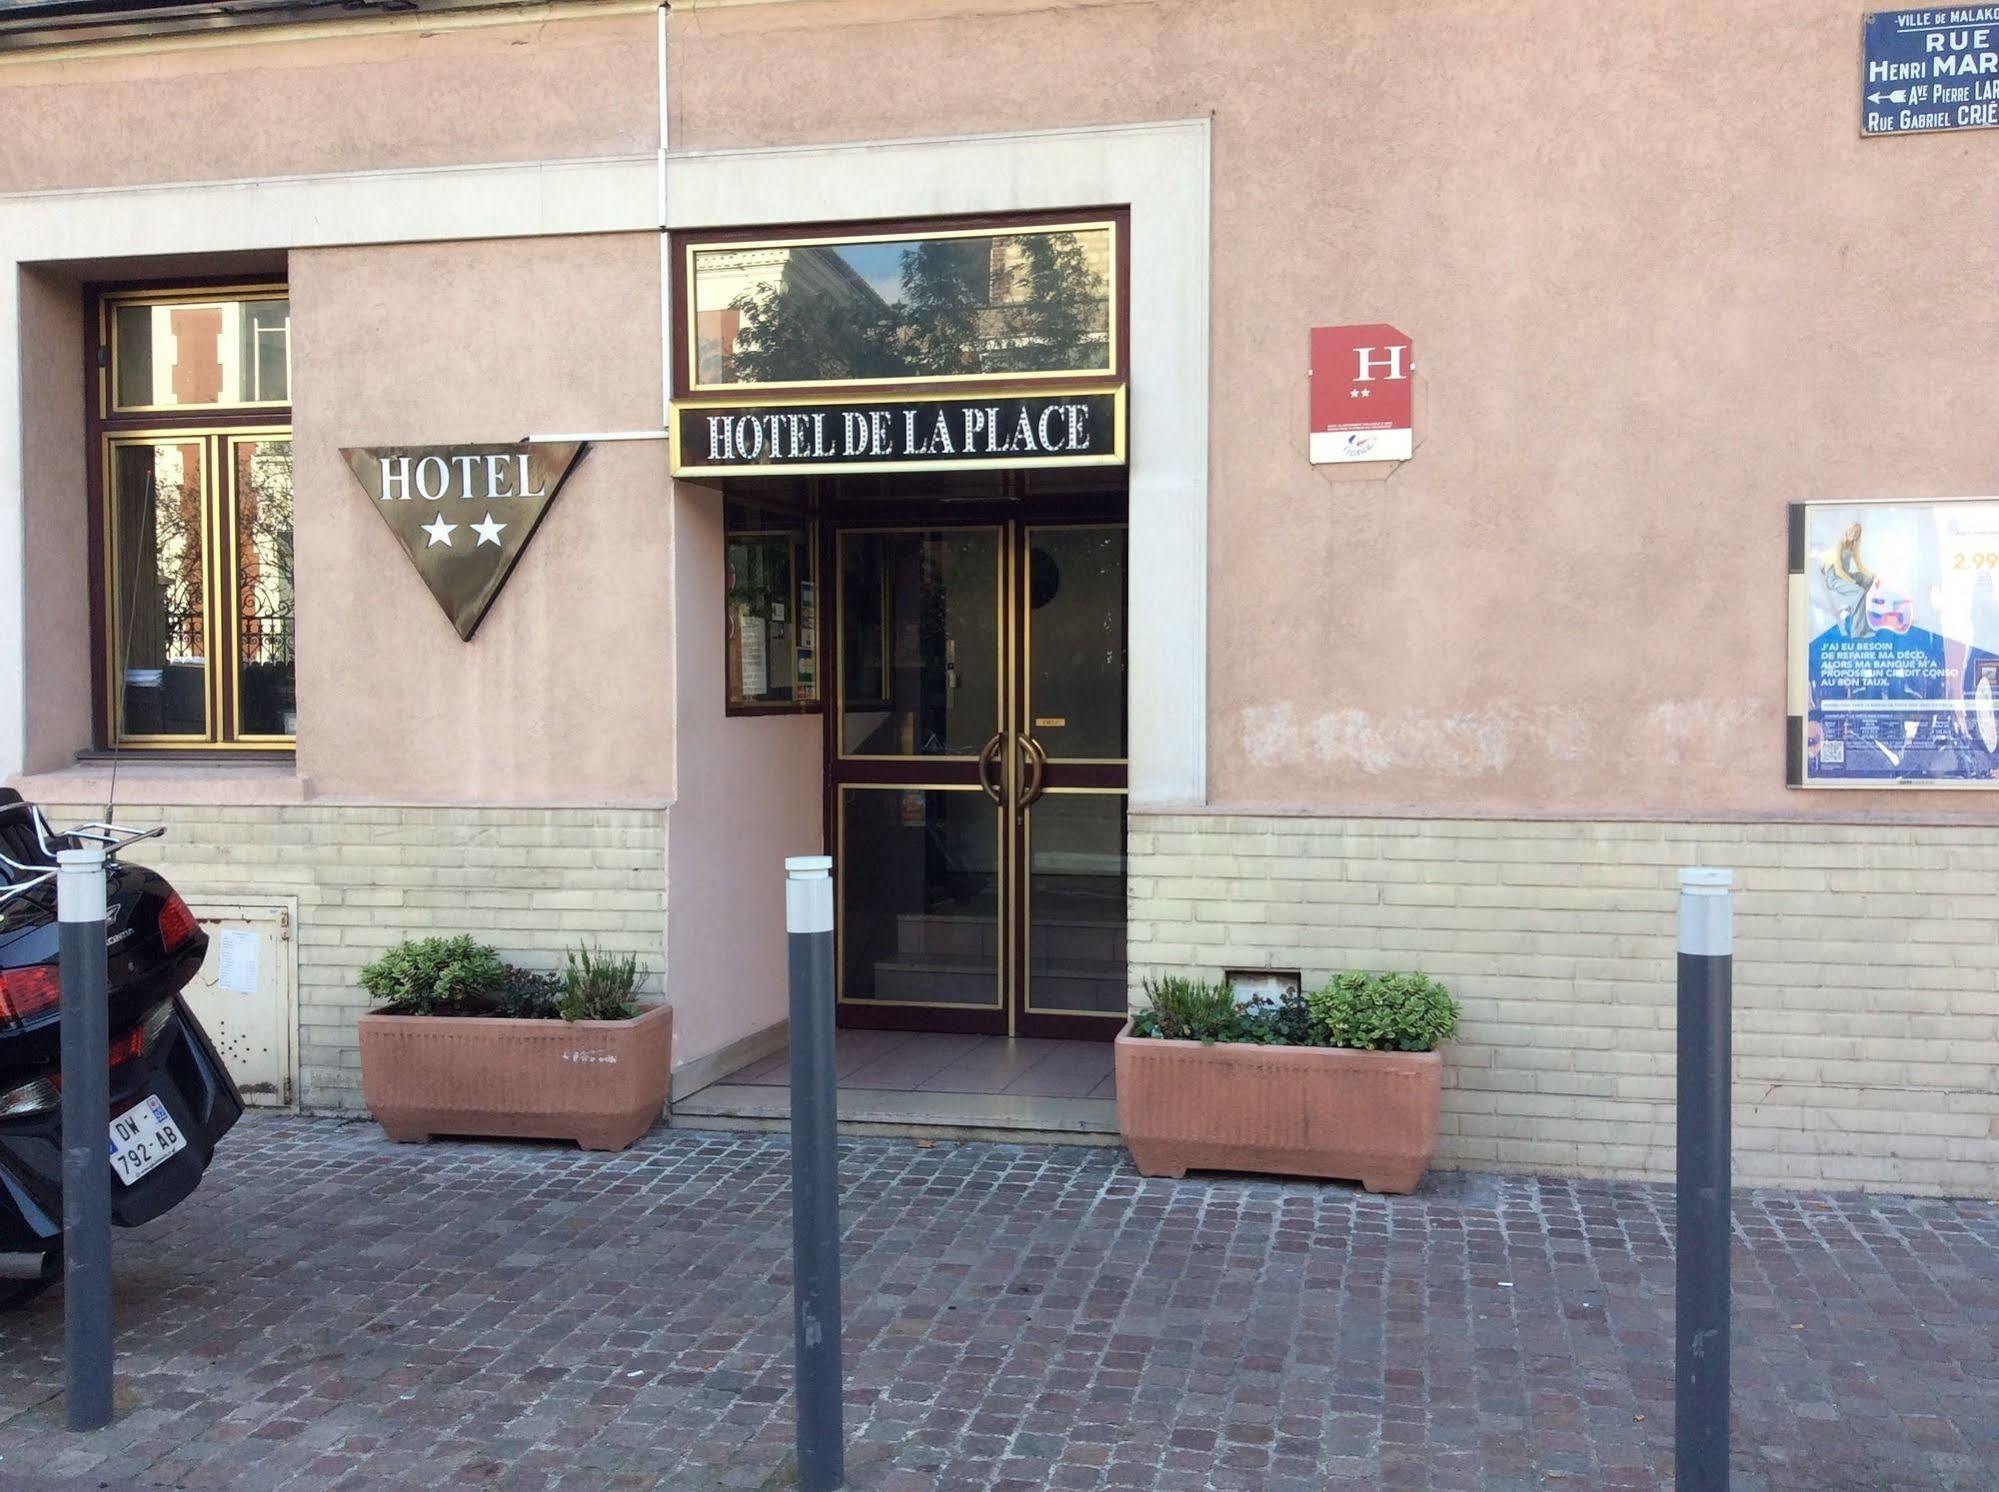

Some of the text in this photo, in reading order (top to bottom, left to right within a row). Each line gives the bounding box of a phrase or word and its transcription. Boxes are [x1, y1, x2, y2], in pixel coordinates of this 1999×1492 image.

[1897, 13, 1931, 27] VILLE
[1926, 29, 1990, 52] RUE
[1933, 52, 1999, 77] MAR
[1957, 101, 1998, 125] CRIÉ
[1352, 345, 1407, 382] H
[707, 404, 1090, 460] HOTEL DE LA PLACE
[379, 454, 545, 501] HOTEL
[1821, 651, 1835, 660] DE
[1837, 651, 1876, 660] REFAIRE
[1878, 651, 1895, 660] MA
[1841, 642, 1855, 651] EU
[1856, 642, 1893, 650] BESOIN
[1821, 661, 1852, 669] ALORS
[1855, 661, 1871, 669] MA
[1873, 661, 1915, 670] BANQUE
[1886, 669, 1920, 678] CDIT
[1821, 679, 1835, 687] AU
[1837, 679, 1860, 687] BON
